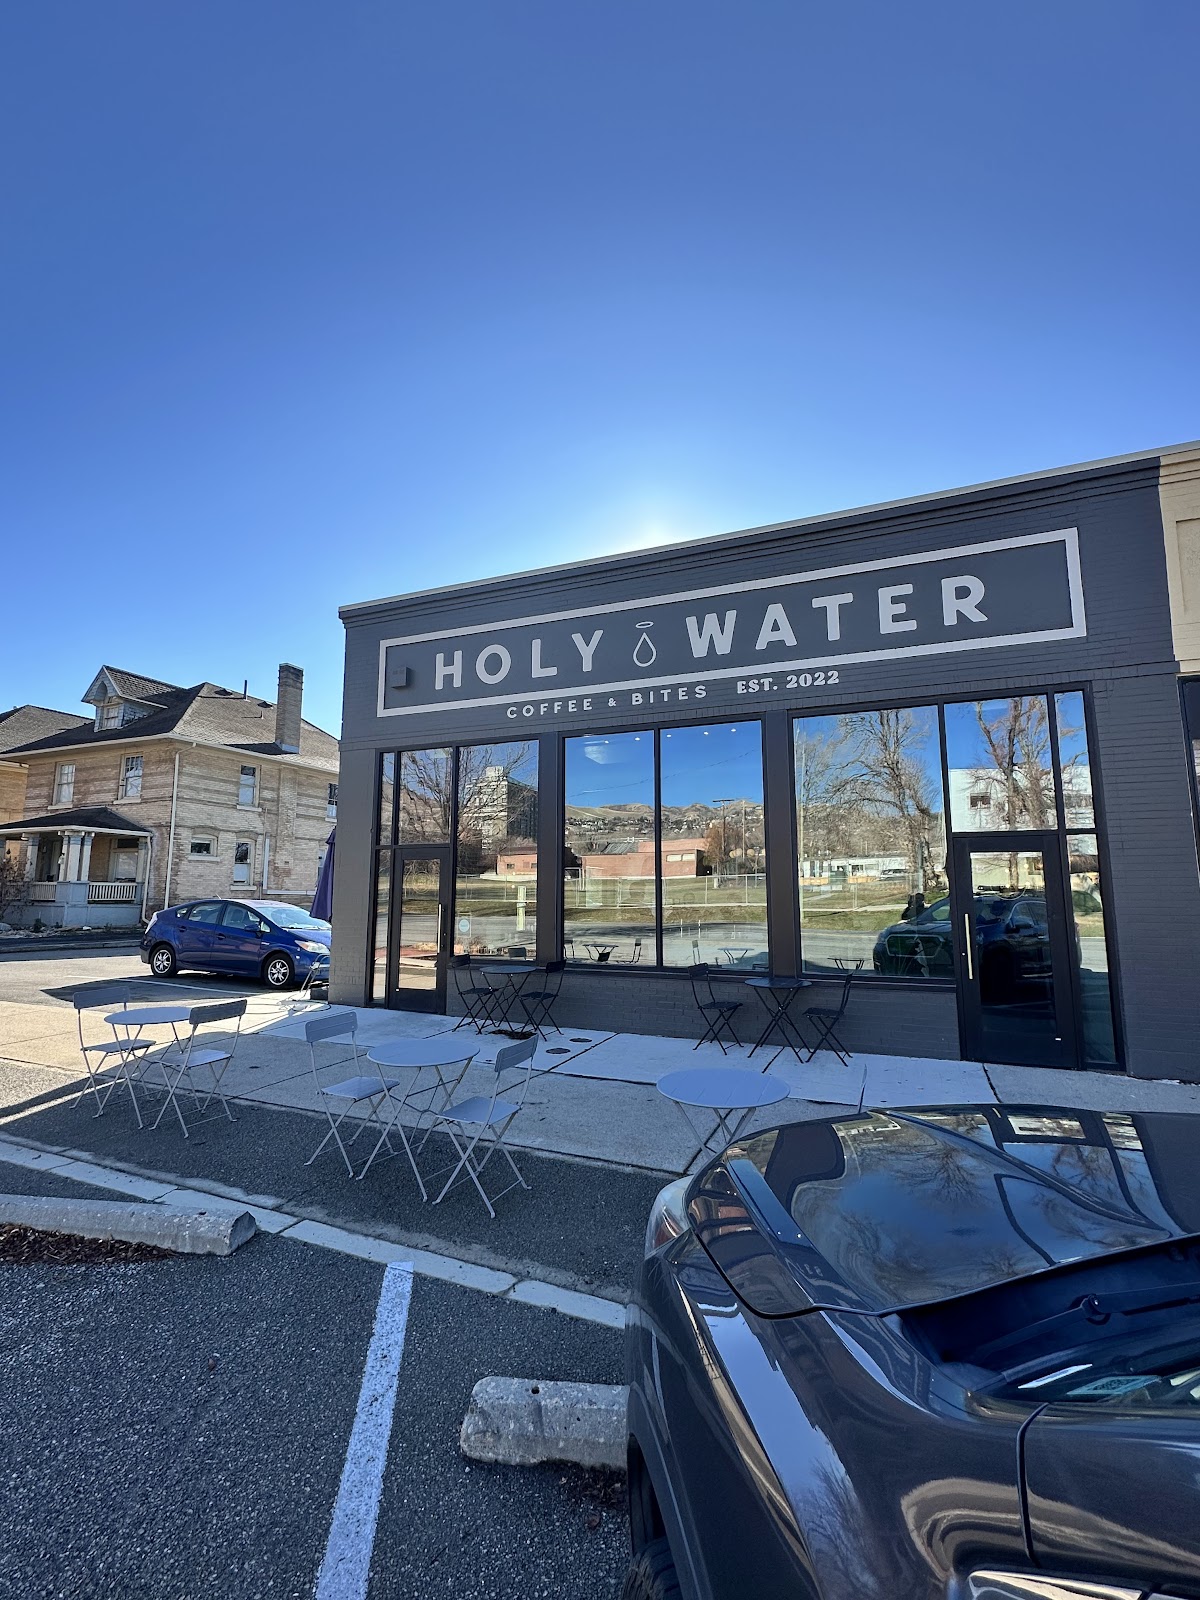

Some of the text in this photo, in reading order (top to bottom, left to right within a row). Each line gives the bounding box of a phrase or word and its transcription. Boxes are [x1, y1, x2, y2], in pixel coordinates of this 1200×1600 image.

[434, 574, 989, 691] HOLY WATER
[736, 670, 840, 694] EST. 2022
[506, 684, 707, 719] COFFEE & BITES
